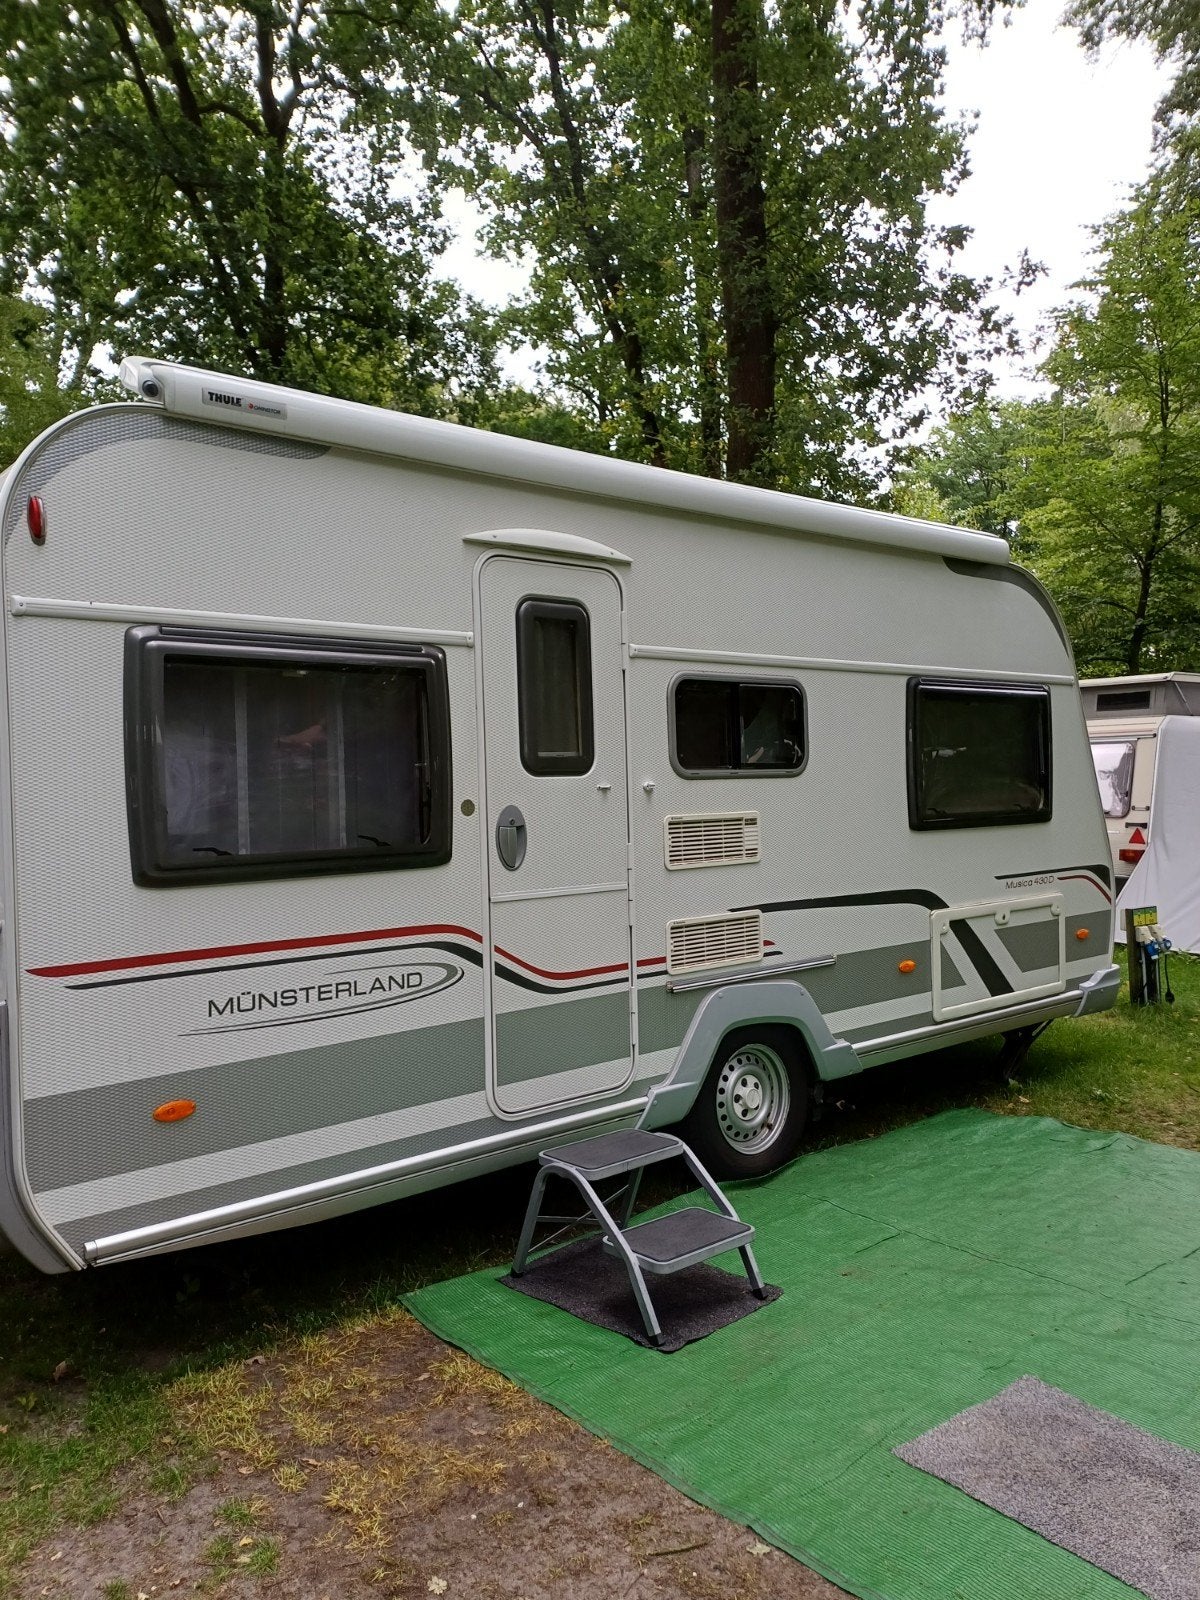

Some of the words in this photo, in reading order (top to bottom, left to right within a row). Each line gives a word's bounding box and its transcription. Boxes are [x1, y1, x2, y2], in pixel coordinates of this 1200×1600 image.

[208, 391, 242, 408] THULE
[1005, 879, 1033, 889] Musica
[1034, 875, 1055, 885] 430D
[208, 972, 423, 1018] MÜNSTERLAND
